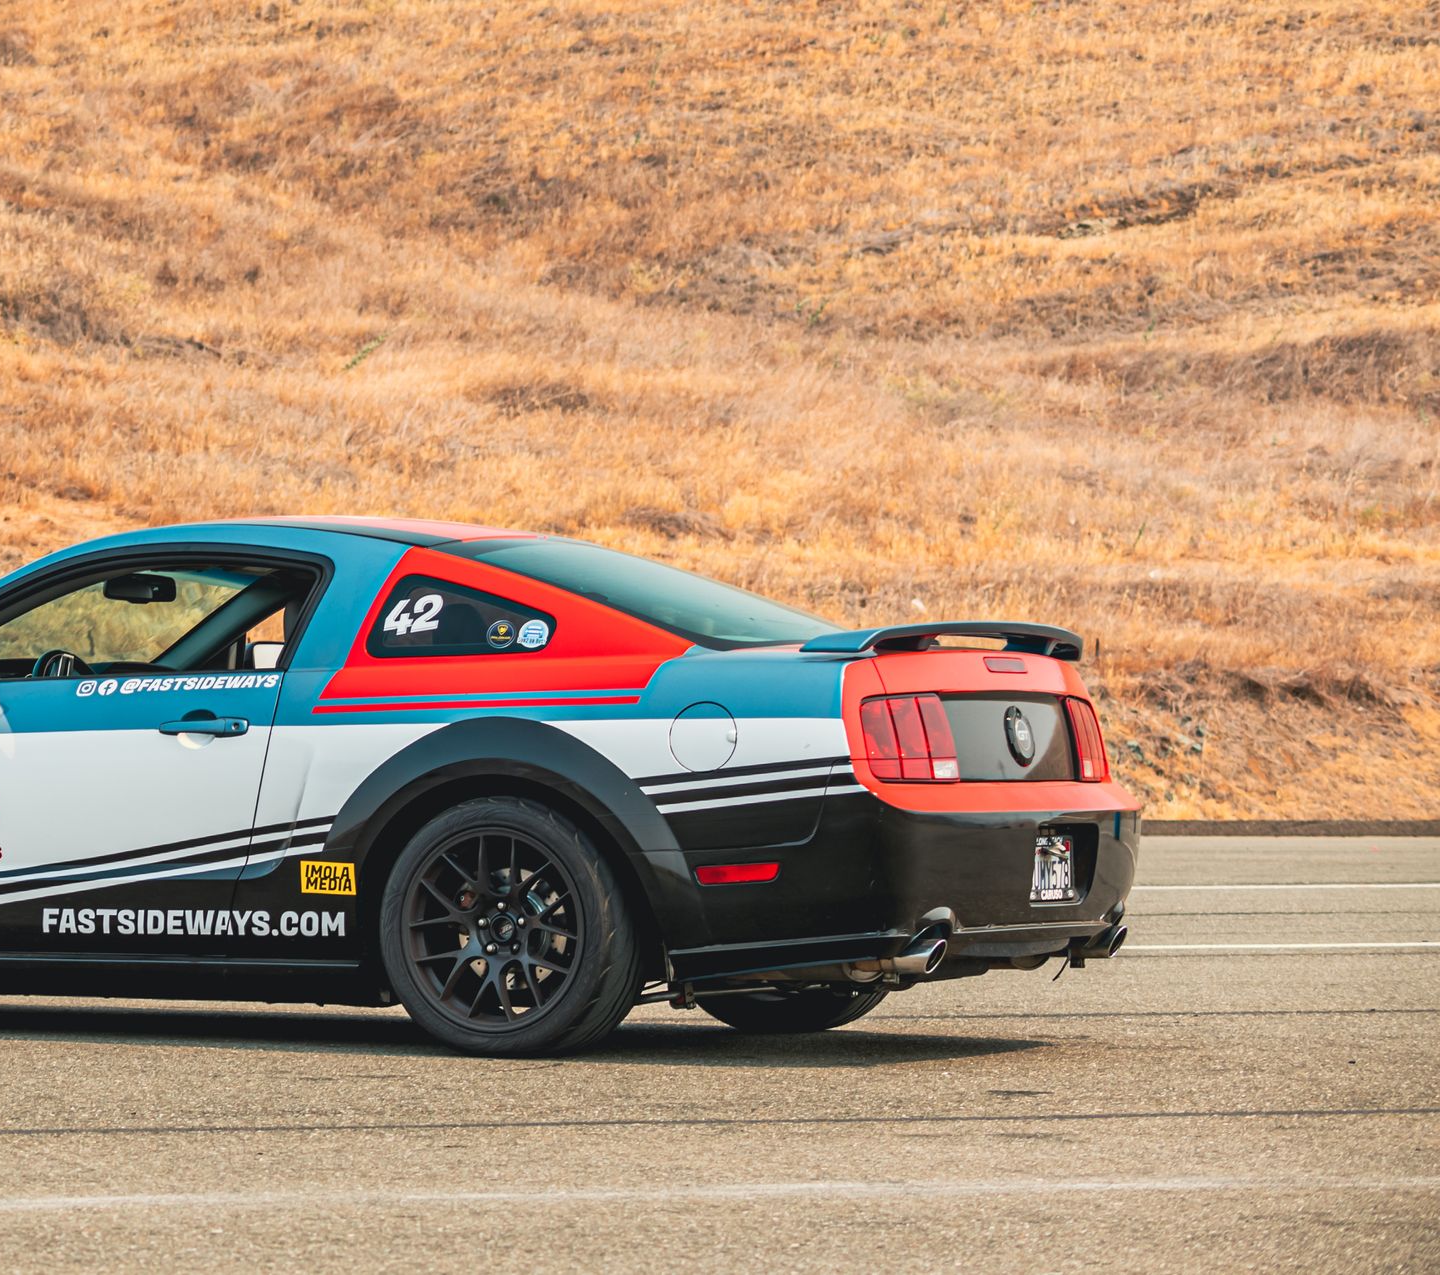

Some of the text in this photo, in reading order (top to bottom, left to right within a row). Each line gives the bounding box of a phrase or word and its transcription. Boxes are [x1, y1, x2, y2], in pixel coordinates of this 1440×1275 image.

[383, 594, 444, 636] 42
[120, 674, 279, 695] @FASTSIDEWAYS
[305, 865, 350, 879] IMOLA
[305, 877, 352, 892] MEDIA
[1040, 889, 1063, 900] CARUSO
[42, 908, 346, 937] FASTSIDEWAYS.COM
